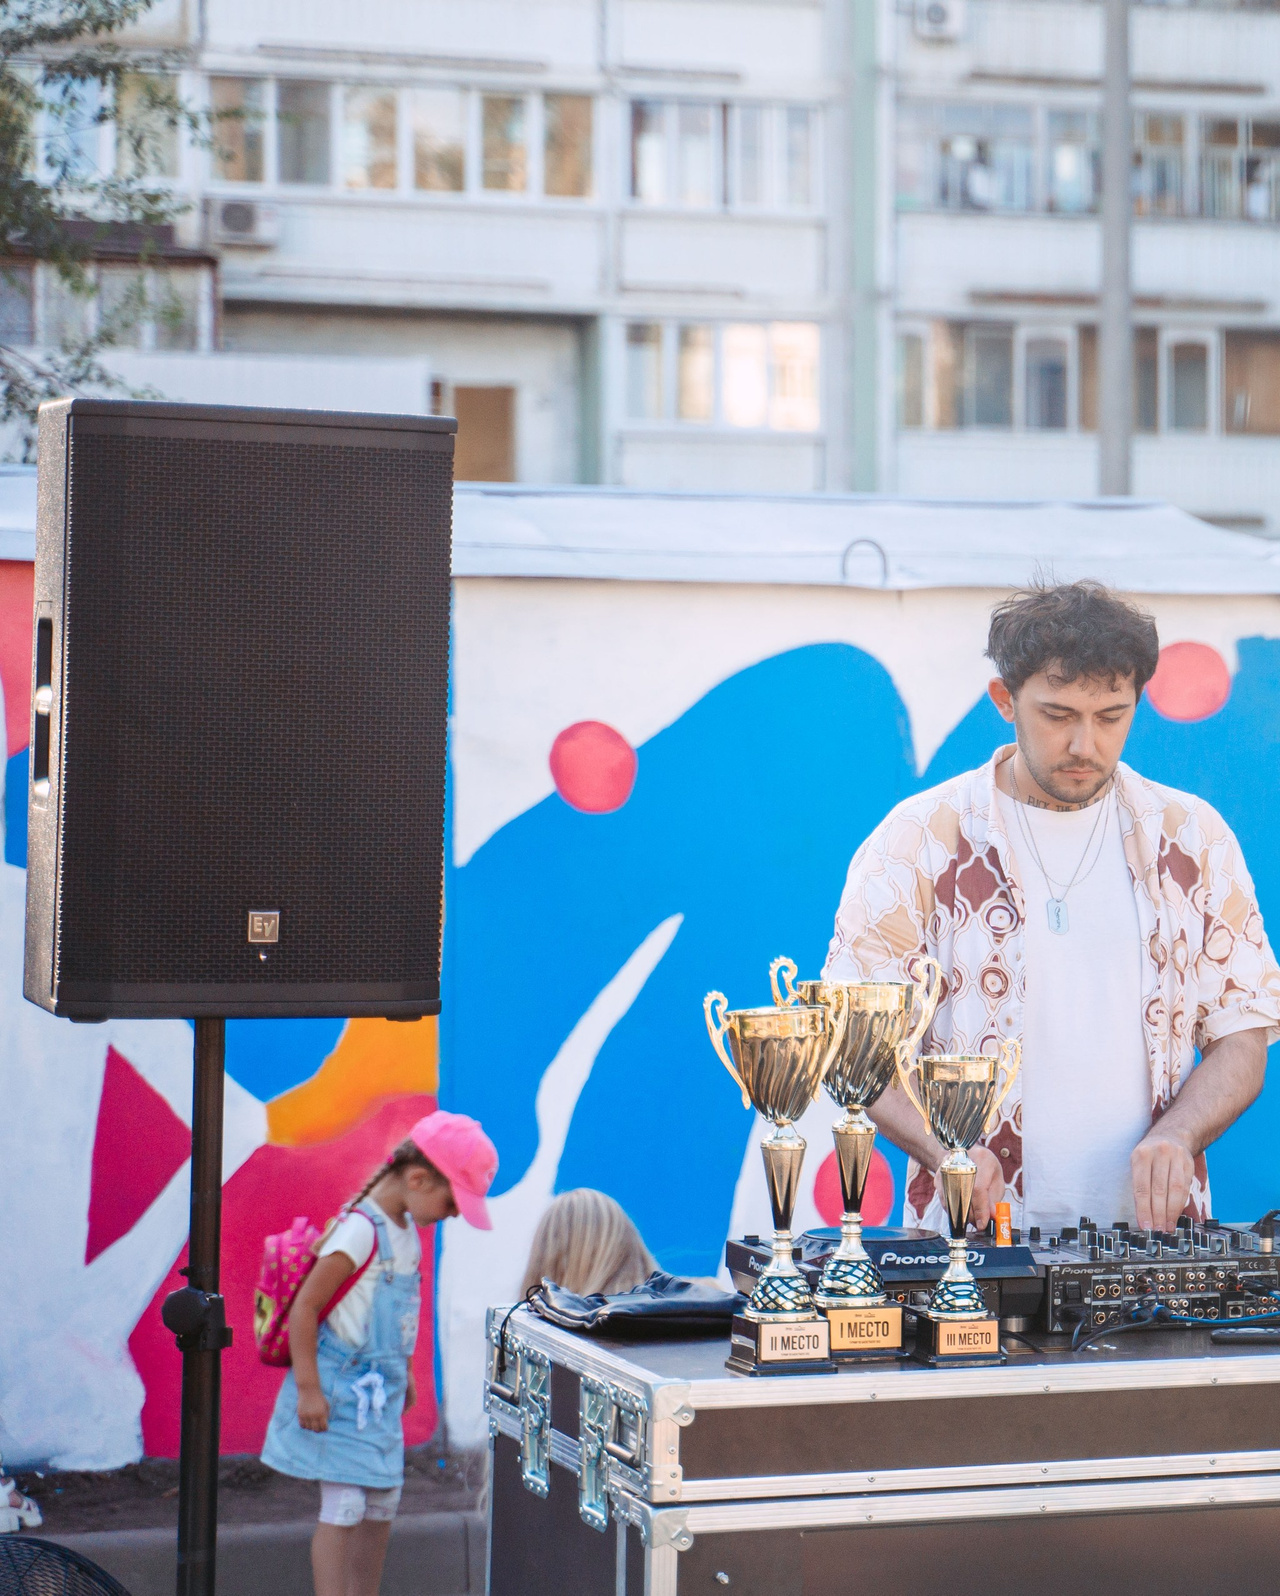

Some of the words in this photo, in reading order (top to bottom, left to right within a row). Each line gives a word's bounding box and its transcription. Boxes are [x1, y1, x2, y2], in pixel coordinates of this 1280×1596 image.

[254, 917, 275, 936] EV
[880, 1252, 951, 1265] Pionee
[1061, 1266, 1106, 1275] Pioneer
[840, 1322, 844, 1338] I
[847, 1321, 889, 1338] МЕСТО
[770, 1336, 777, 1351] II
[781, 1334, 819, 1351] МЕСТО
[946, 1333, 956, 1346] III
[958, 1332, 992, 1346] МЕСТО
